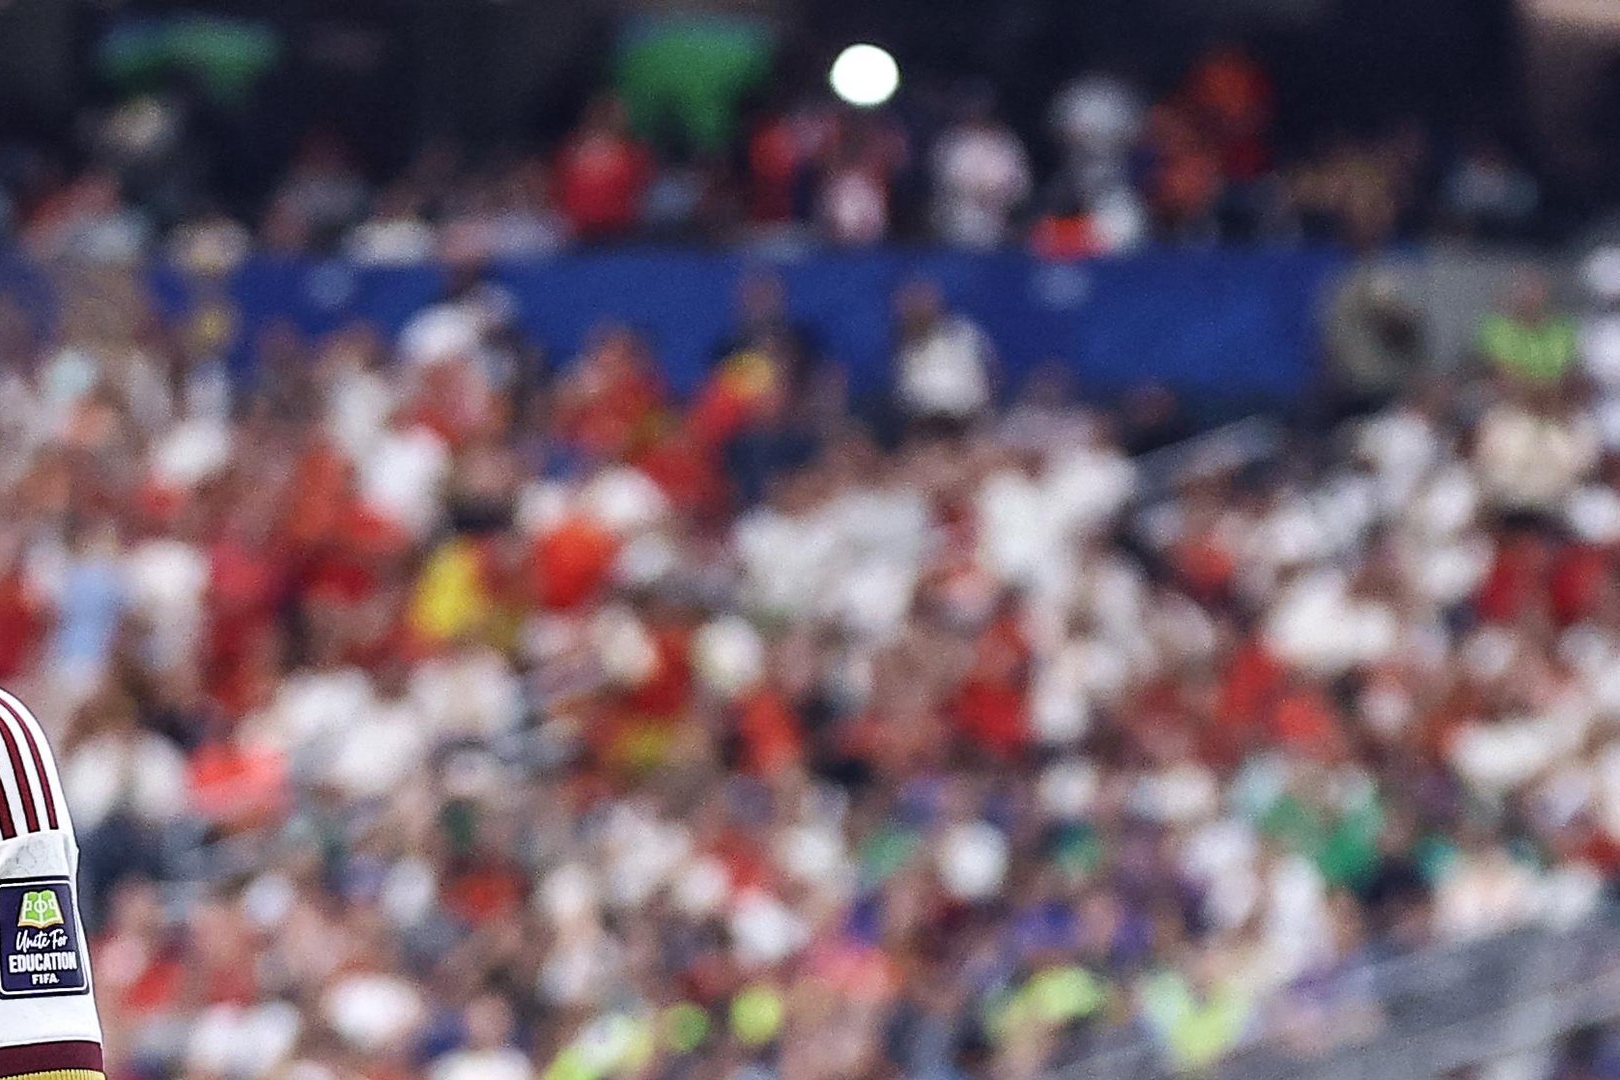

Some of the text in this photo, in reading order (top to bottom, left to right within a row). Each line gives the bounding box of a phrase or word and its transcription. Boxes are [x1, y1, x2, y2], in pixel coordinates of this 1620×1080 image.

[16, 928, 68, 953] Unite For
[8, 951, 78, 973] EDUCATION
[31, 973, 60, 985] FIFA
